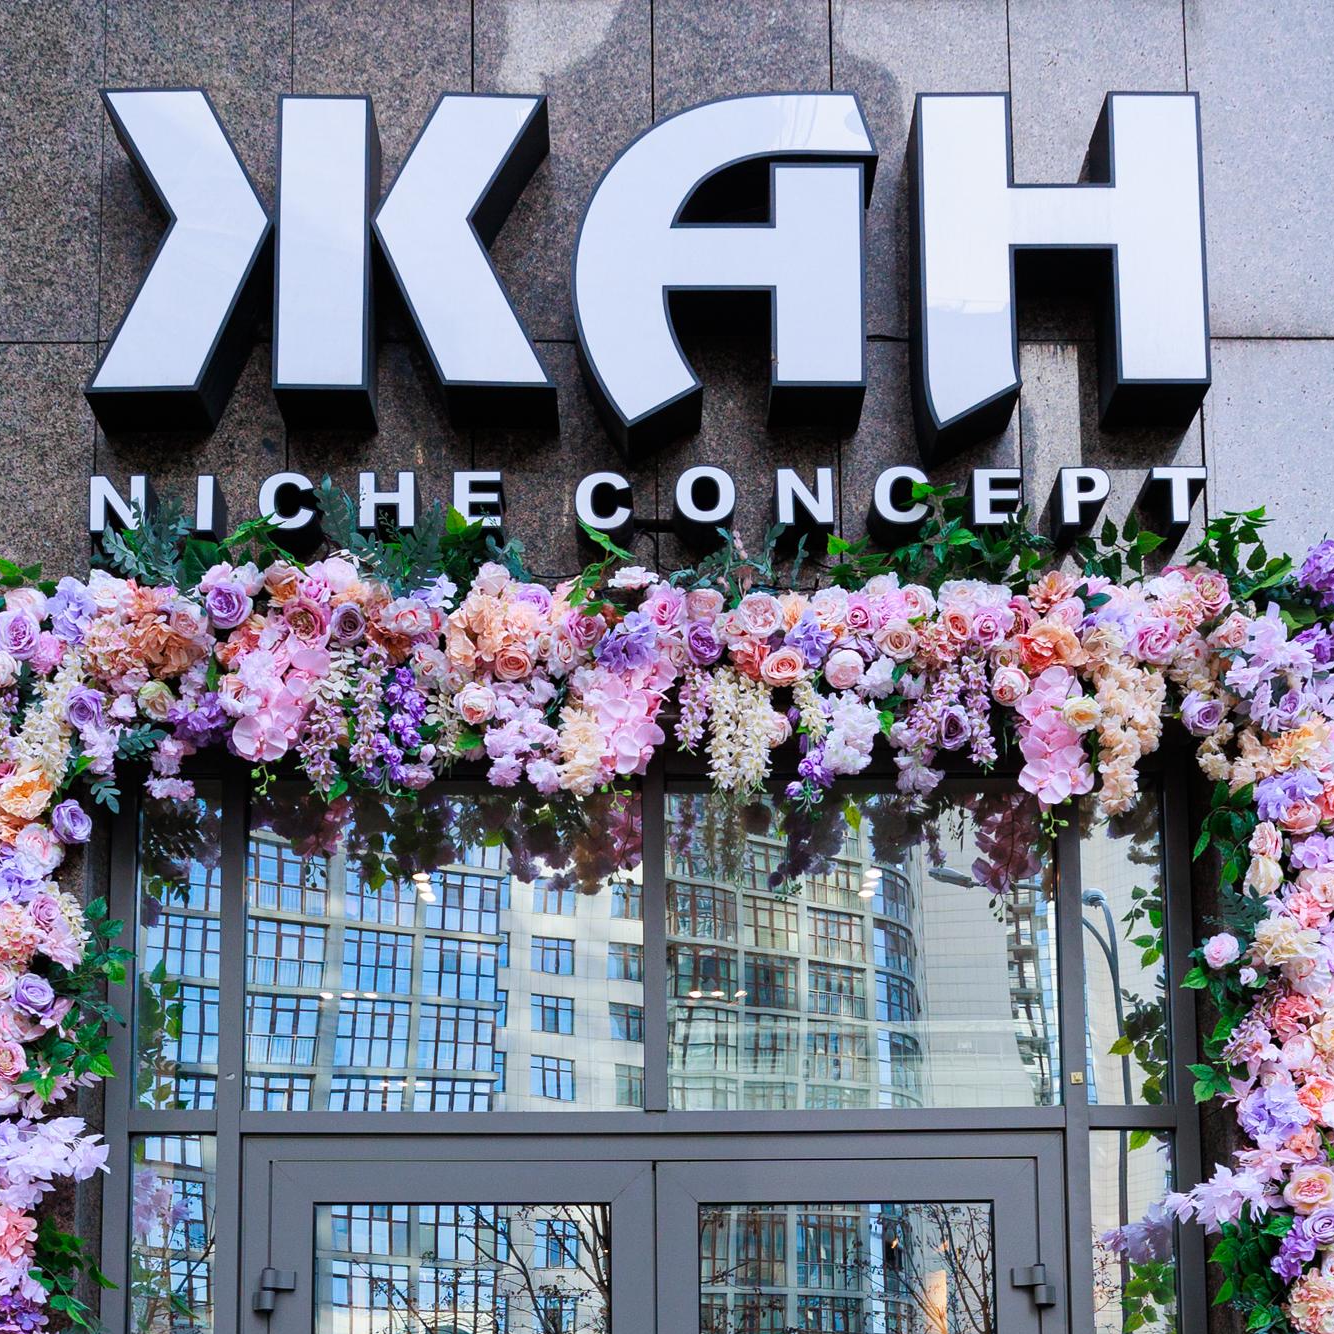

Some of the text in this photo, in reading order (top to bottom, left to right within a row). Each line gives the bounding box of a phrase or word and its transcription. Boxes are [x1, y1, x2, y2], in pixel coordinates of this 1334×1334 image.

[84, 88, 1213, 436] ЖАН
[88, 464, 1208, 531] NICHE CONCEPT
